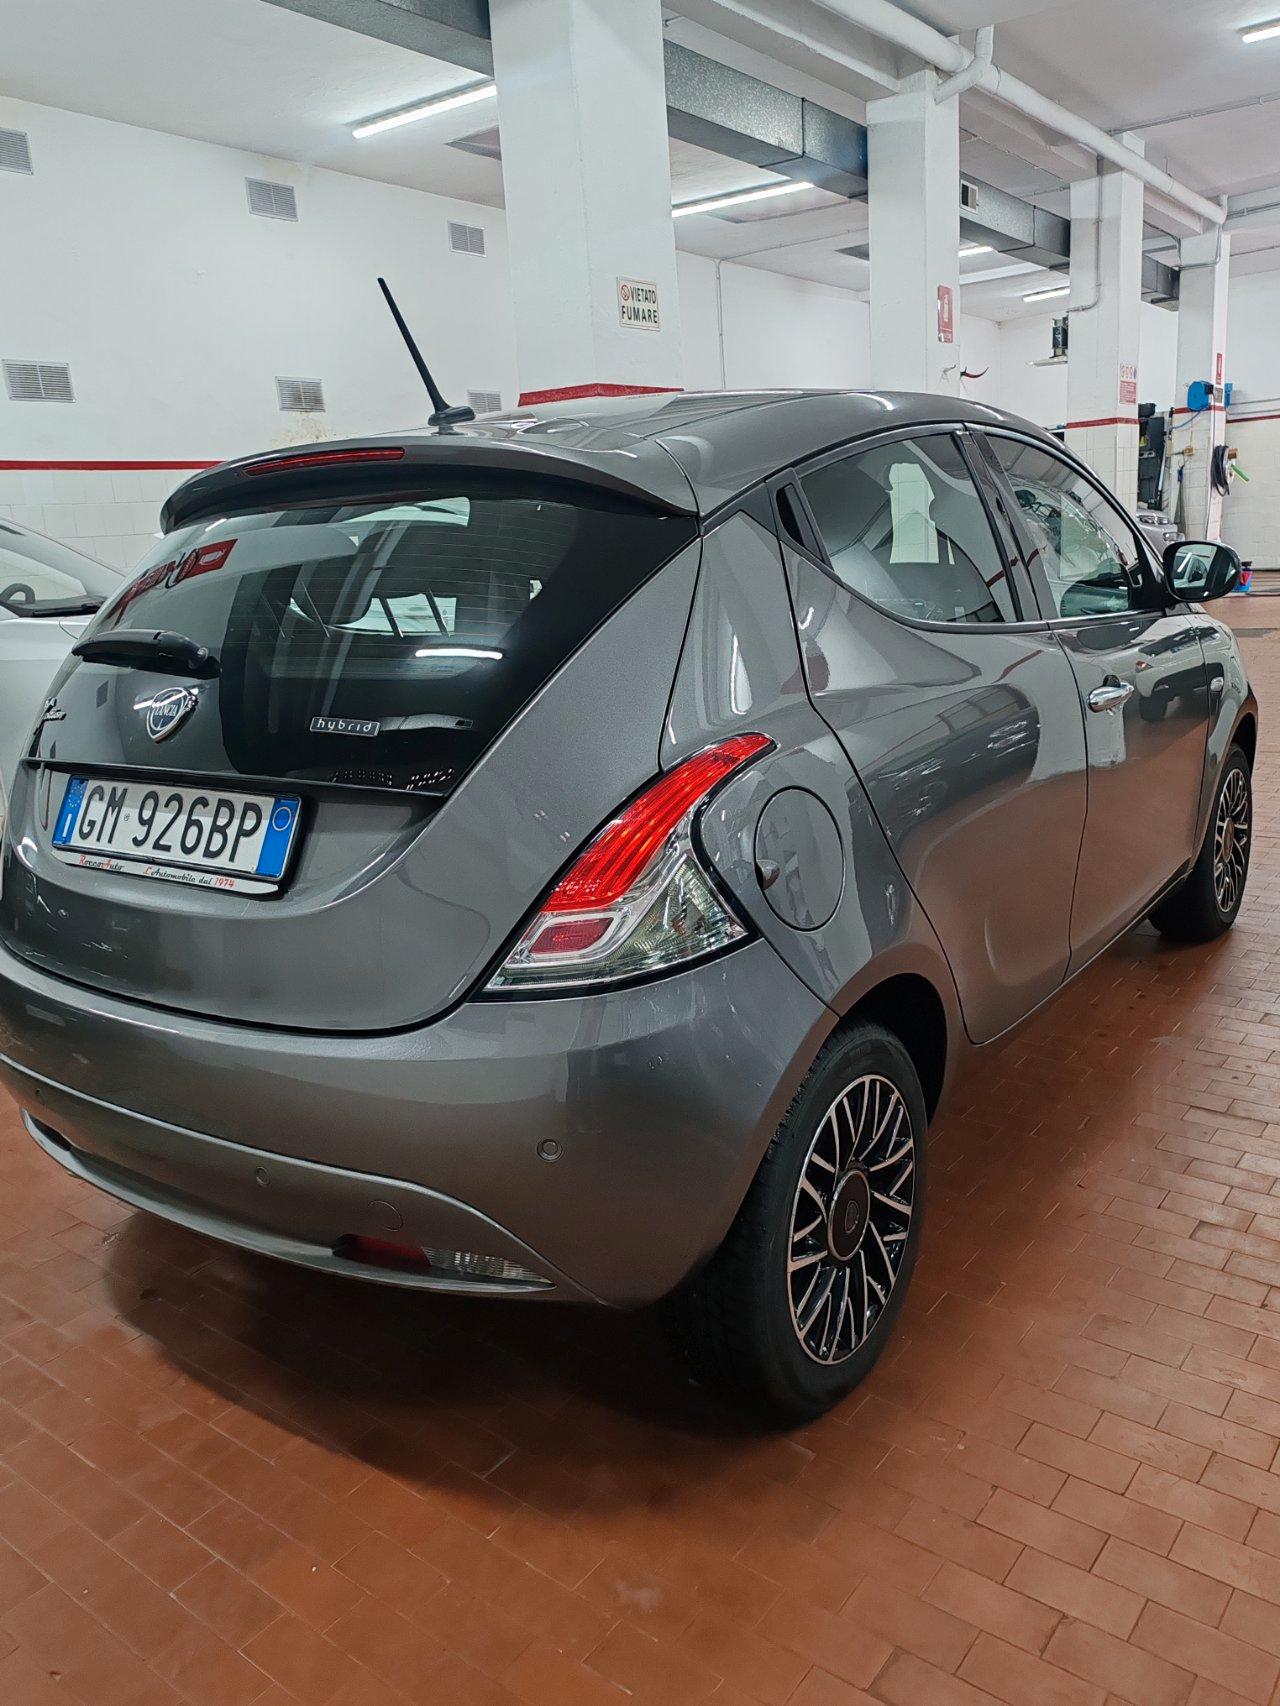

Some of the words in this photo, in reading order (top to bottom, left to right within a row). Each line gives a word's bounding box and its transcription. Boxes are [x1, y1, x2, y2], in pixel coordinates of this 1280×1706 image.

[630, 286, 656, 304] VIETATO
[621, 305, 658, 323] FUMARE
[316, 718, 373, 733] hybrid
[78, 784, 128, 845] GM
[131, 789, 263, 863] 926BP
[198, 876, 213, 885] dal
[214, 876, 236, 888] 1974
